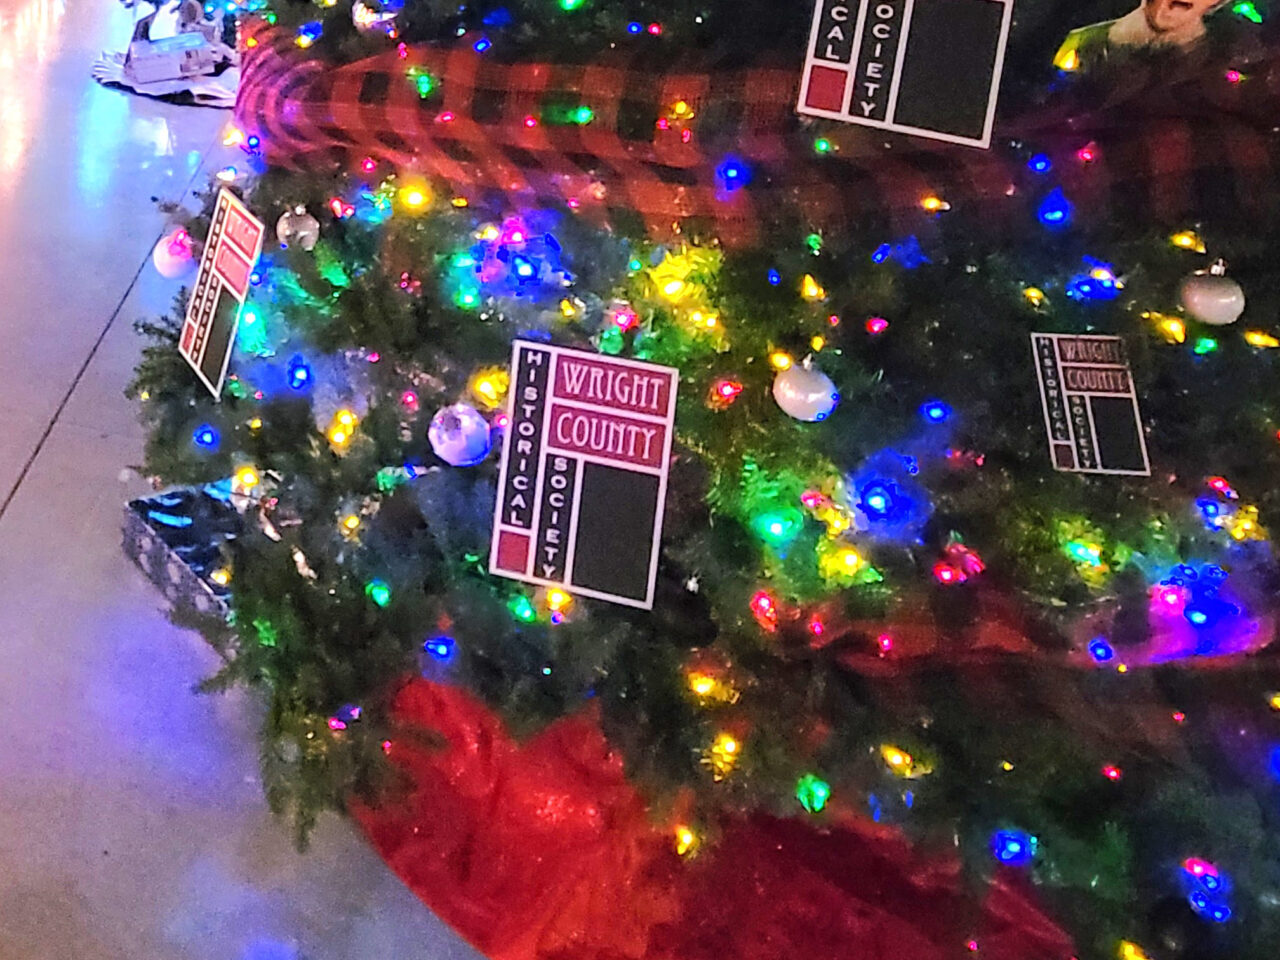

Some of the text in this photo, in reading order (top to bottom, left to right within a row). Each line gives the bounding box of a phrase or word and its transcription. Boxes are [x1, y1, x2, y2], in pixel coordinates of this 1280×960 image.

[562, 361, 664, 410] WRIGHT
[511, 350, 542, 526] HISTORICAL
[556, 412, 656, 460] COUNTY
[542, 457, 568, 578] SOCIETY
